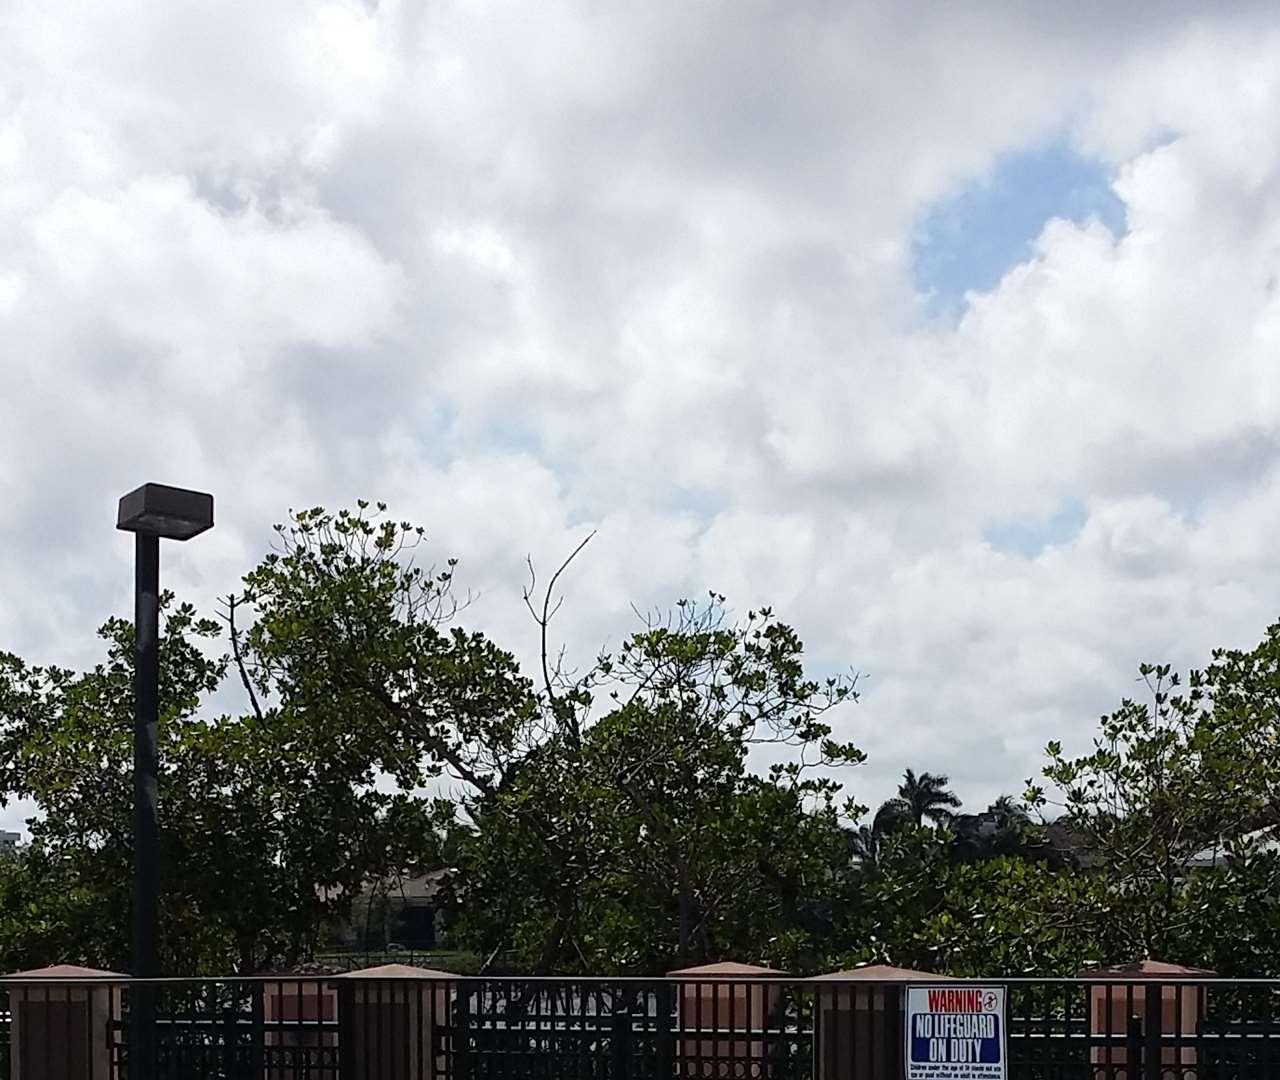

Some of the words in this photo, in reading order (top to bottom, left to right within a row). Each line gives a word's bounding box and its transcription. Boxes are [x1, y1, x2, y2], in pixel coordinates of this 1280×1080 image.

[928, 990, 982, 1012] WARNING
[916, 1014, 932, 1038] NO
[934, 1015, 995, 1038] LIFEGUARD
[929, 1039, 947, 1062] ON
[951, 1039, 982, 1062] DUTY
